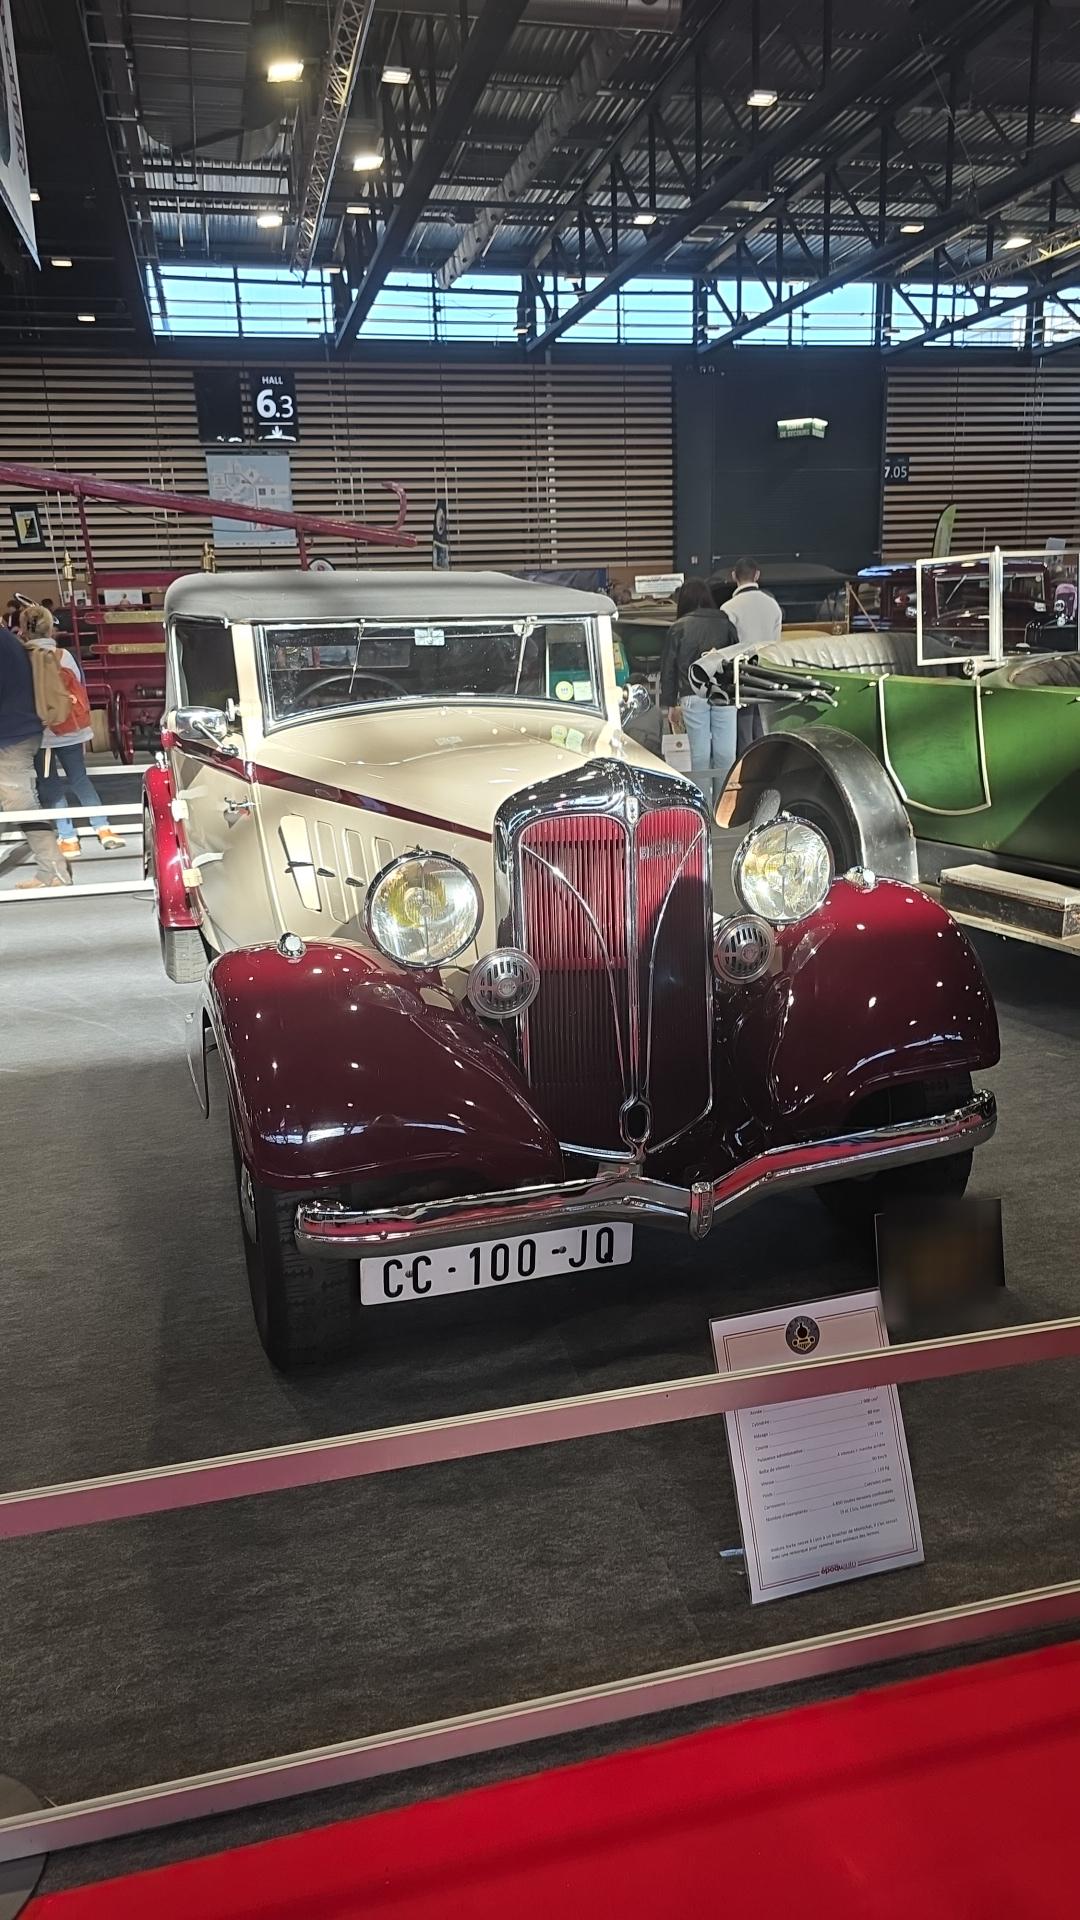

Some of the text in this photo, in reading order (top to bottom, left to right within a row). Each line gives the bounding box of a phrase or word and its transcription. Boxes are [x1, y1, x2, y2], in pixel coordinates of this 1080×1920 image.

[262, 376, 283, 385] HALL
[256, 388, 294, 418] 6.3
[884, 466, 907, 479] 7.05
